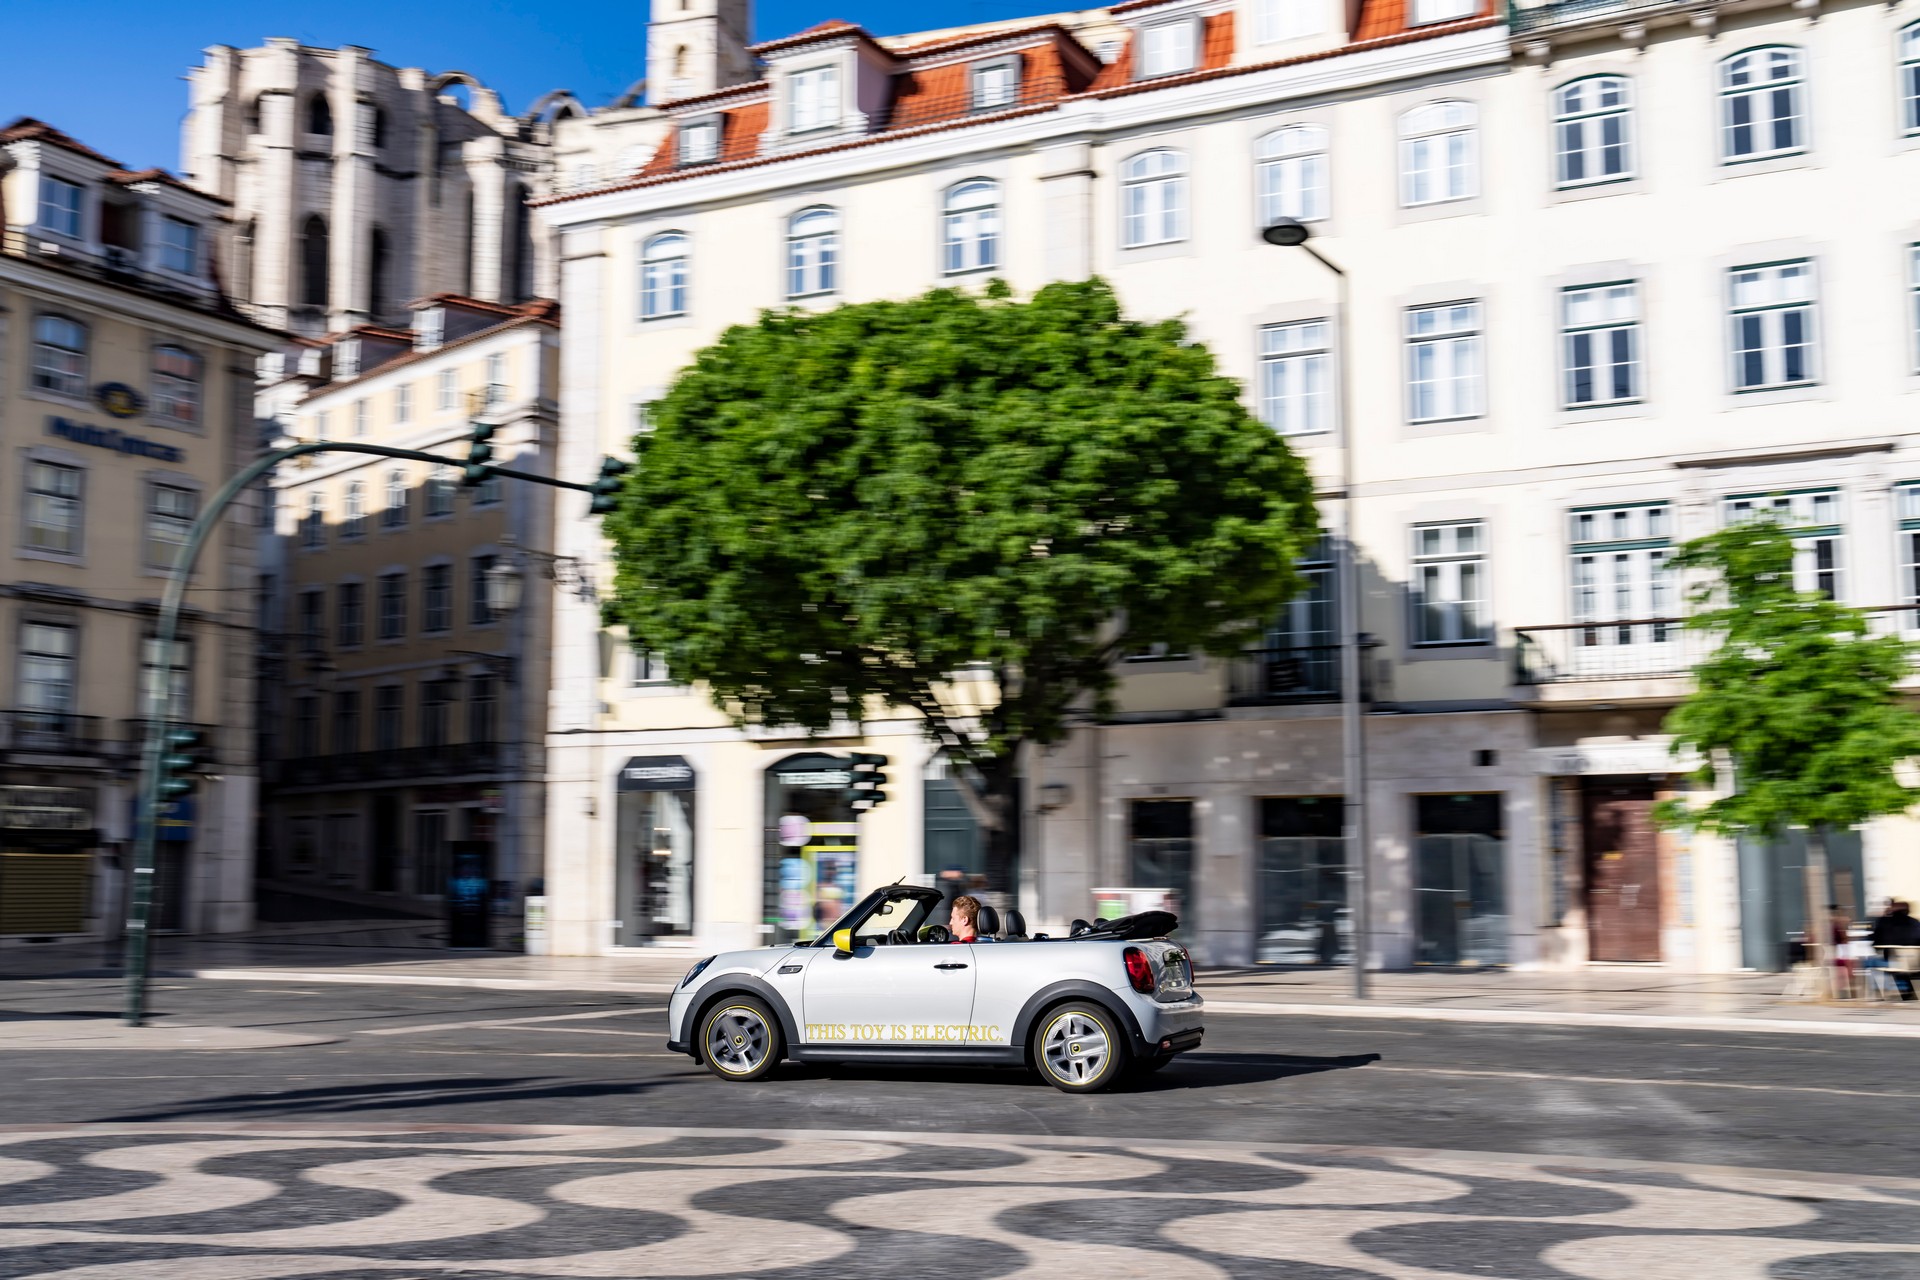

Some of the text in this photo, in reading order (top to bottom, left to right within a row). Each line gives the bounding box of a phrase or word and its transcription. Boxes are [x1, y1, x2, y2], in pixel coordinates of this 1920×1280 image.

[805, 1023, 1004, 1042] THIS TOY IS ELECTRIC.
